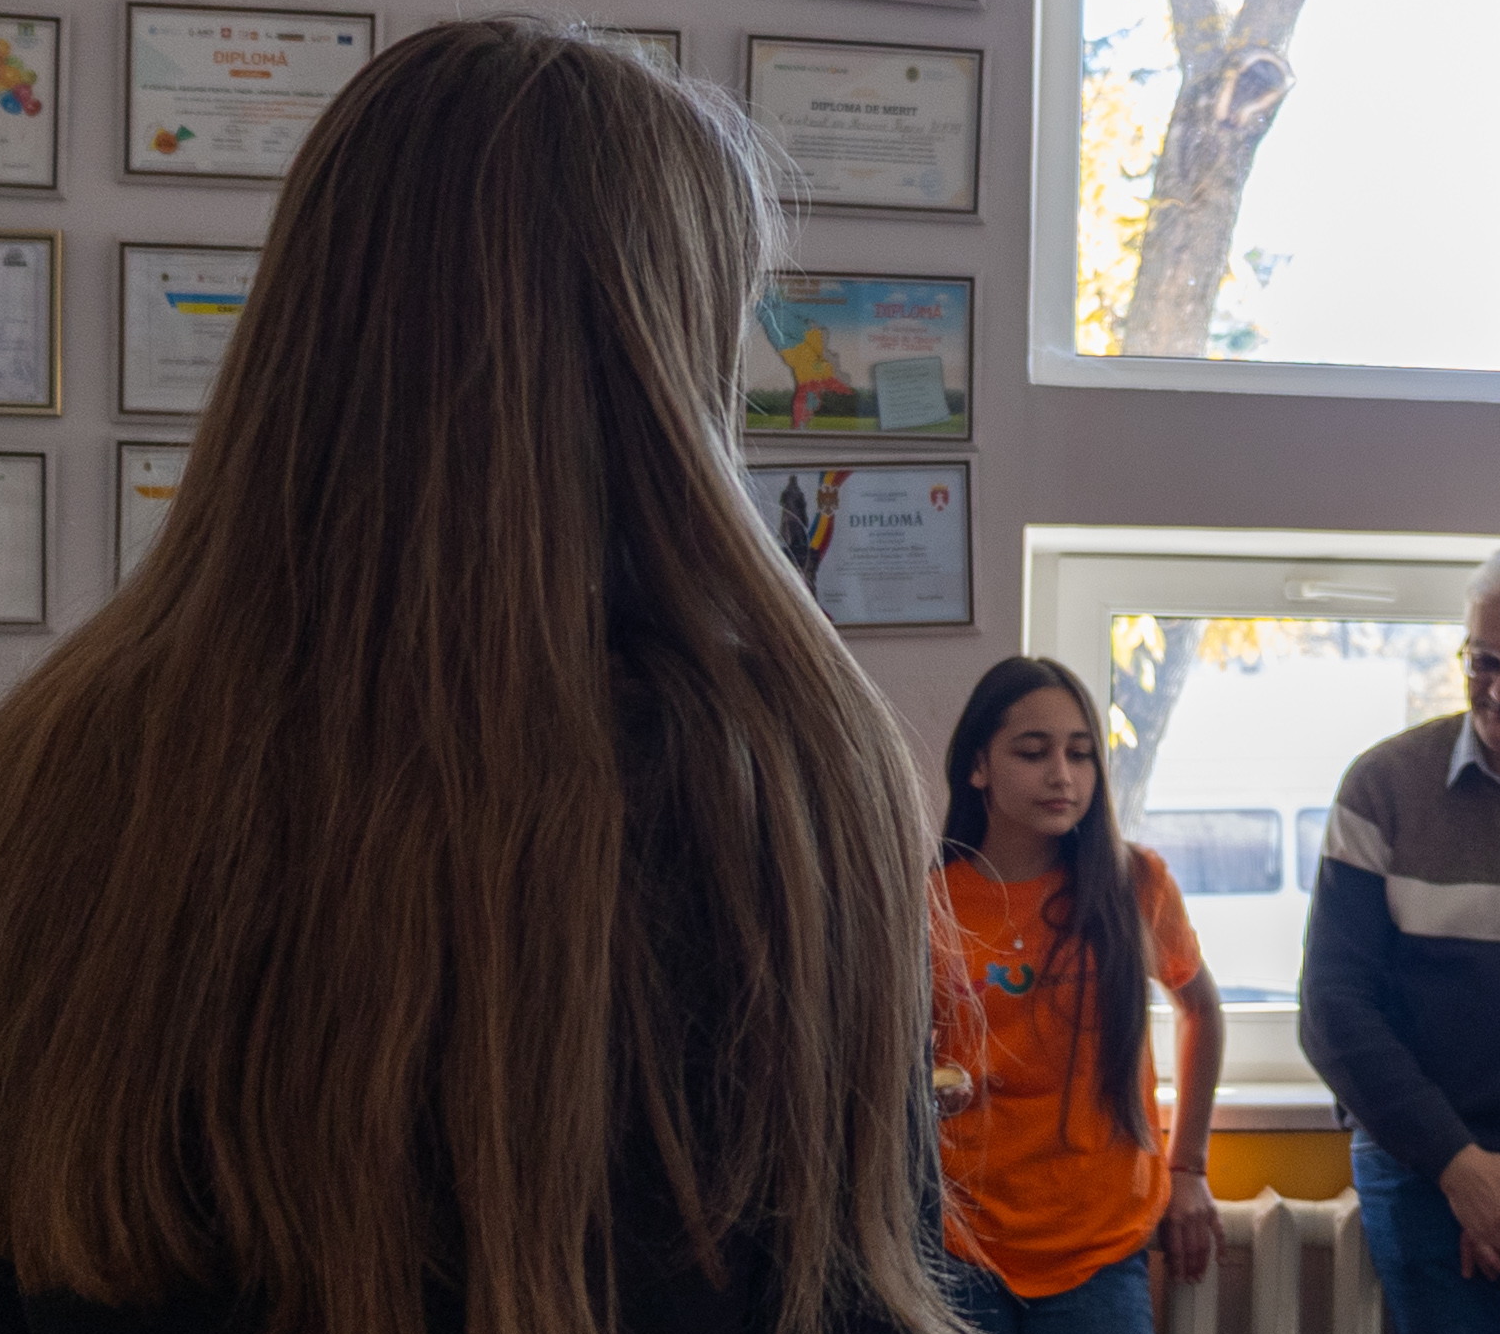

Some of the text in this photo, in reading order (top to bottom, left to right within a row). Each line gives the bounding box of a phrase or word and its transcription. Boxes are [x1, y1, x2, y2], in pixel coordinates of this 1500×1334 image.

[213, 50, 289, 68] DIPLOMĂ
[811, 101, 919, 117] DIPLOMA DE MERIT
[874, 303, 943, 319] DIPLOMĂ
[849, 511, 923, 528] DIPLOMĂ
